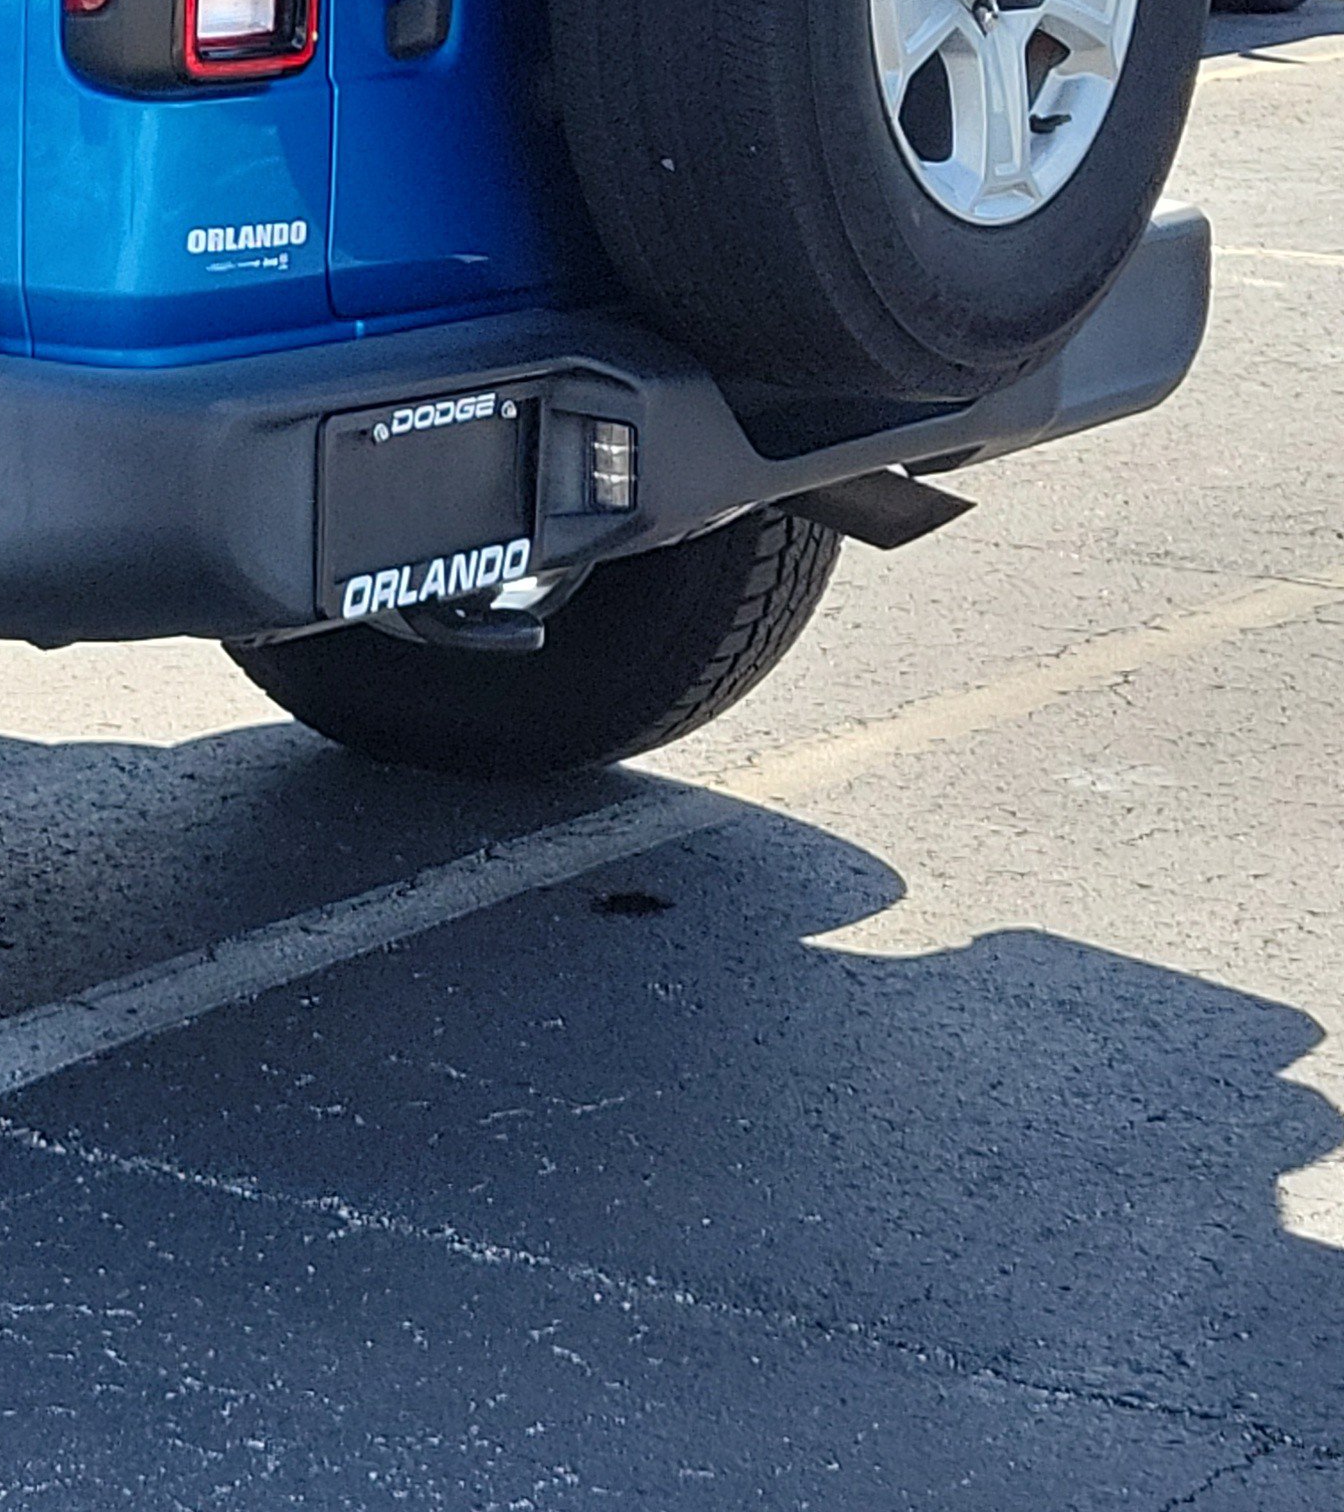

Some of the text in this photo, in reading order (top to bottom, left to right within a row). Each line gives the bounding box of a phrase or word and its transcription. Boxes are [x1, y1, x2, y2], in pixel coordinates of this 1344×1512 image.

[187, 220, 307, 254] ORLANDO
[391, 392, 496, 435] DODGE
[342, 538, 531, 619] ORLANDO
